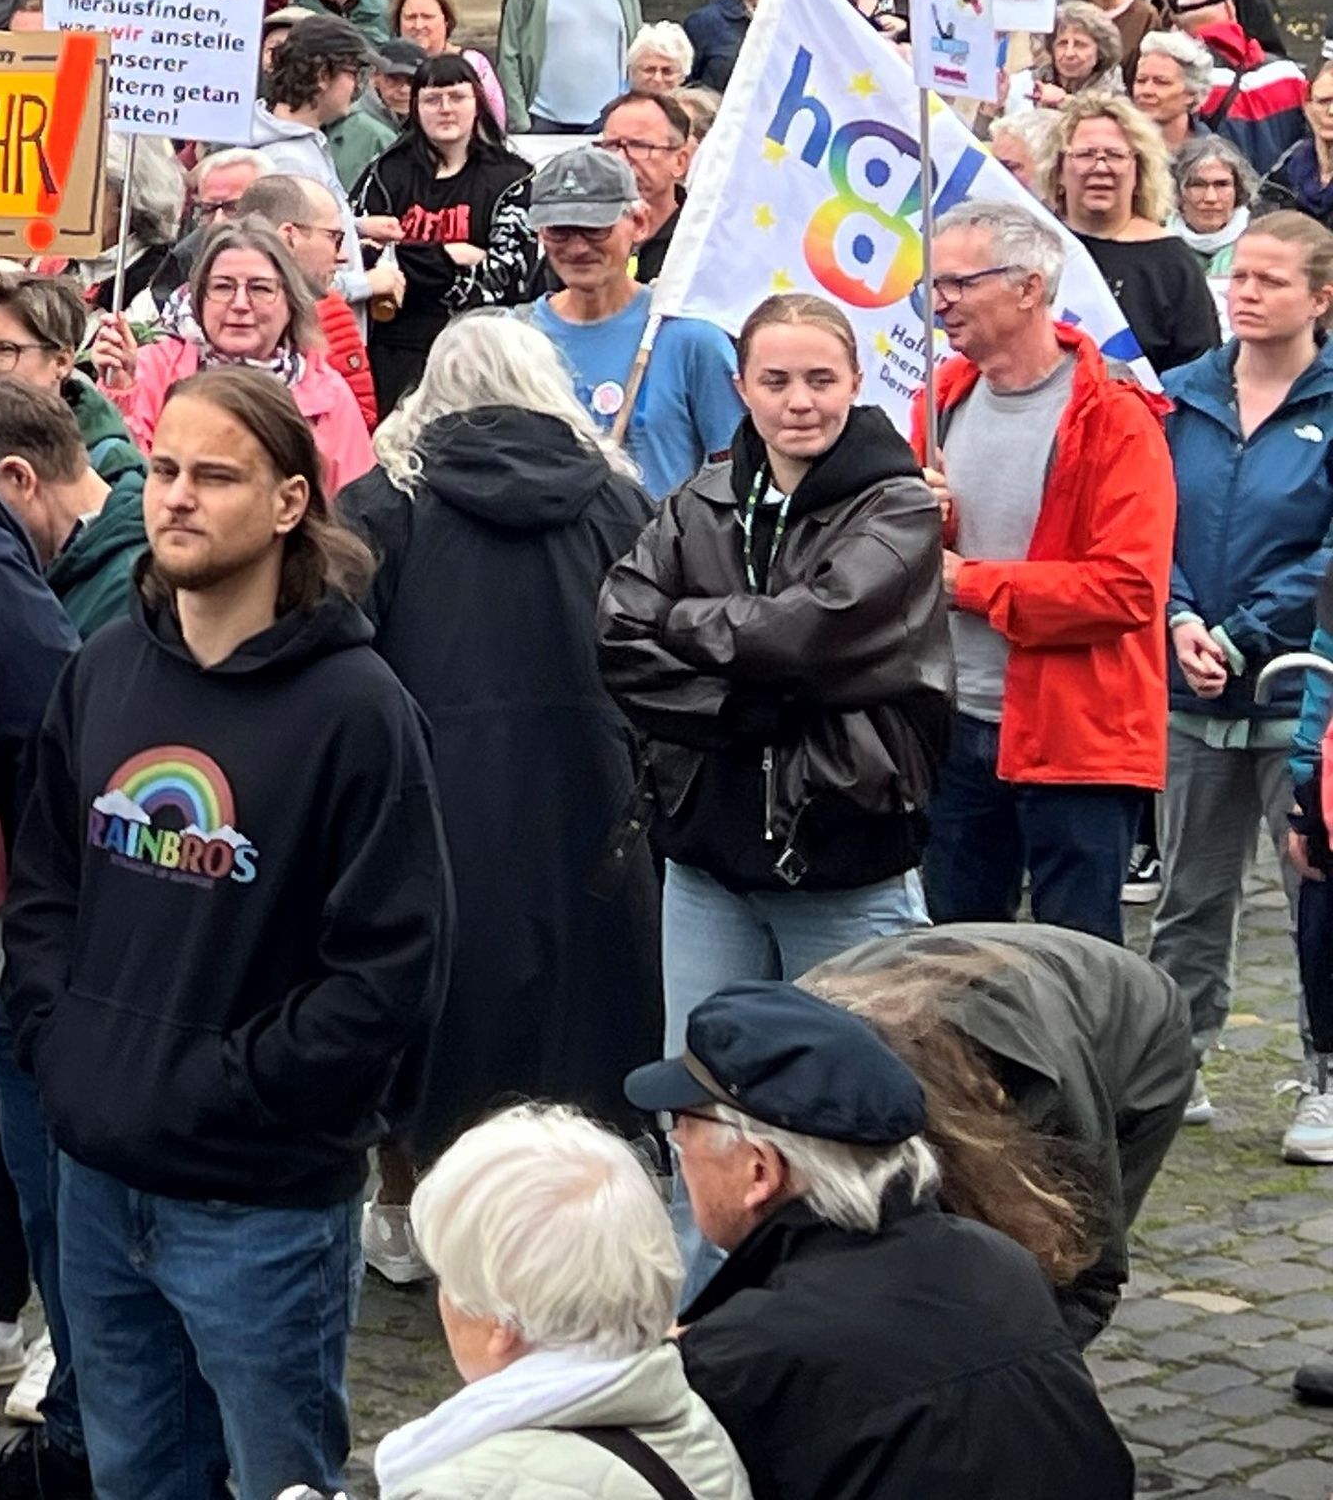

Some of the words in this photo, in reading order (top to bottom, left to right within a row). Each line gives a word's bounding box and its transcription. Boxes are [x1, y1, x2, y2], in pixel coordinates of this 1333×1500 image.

[105, 24, 144, 42] wir
[151, 30, 245, 53] anstelle
[110, 53, 189, 73] nserer
[108, 76, 165, 98] ltern
[173, 85, 240, 105] getan
[107, 102, 180, 127] ätten!
[87, 807, 259, 884] RAINBROS
